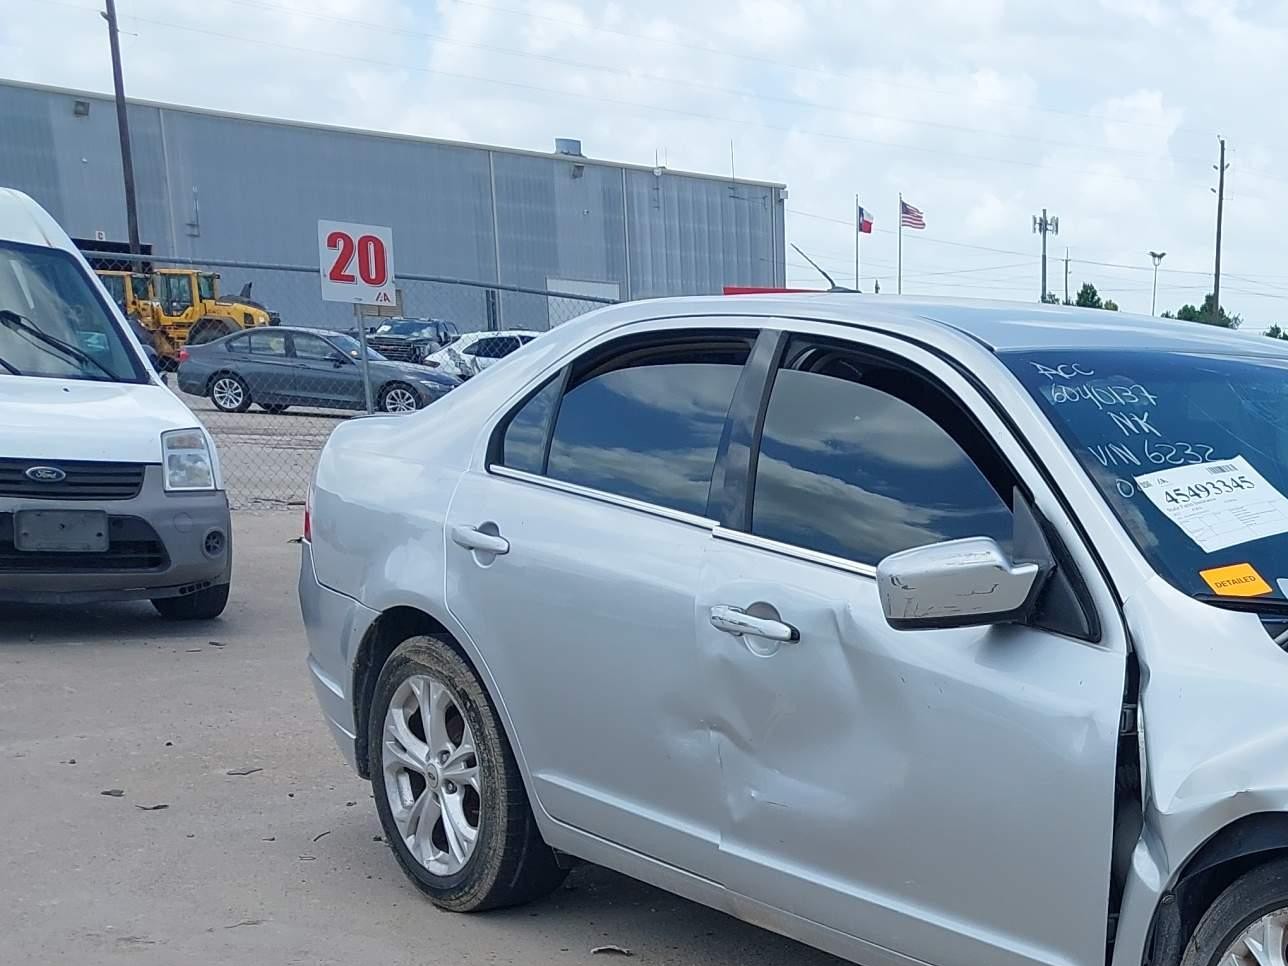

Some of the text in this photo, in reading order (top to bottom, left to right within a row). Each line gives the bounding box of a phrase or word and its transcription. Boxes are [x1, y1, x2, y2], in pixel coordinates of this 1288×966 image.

[326, 231, 388, 287] 20
[1029, 361, 1095, 380] ACC
[1106, 411, 1162, 437] NK
[1087, 439, 1222, 466] VIN 6232
[1164, 476, 1255, 506] 45493345
[1214, 575, 1257, 589] DETAILED
